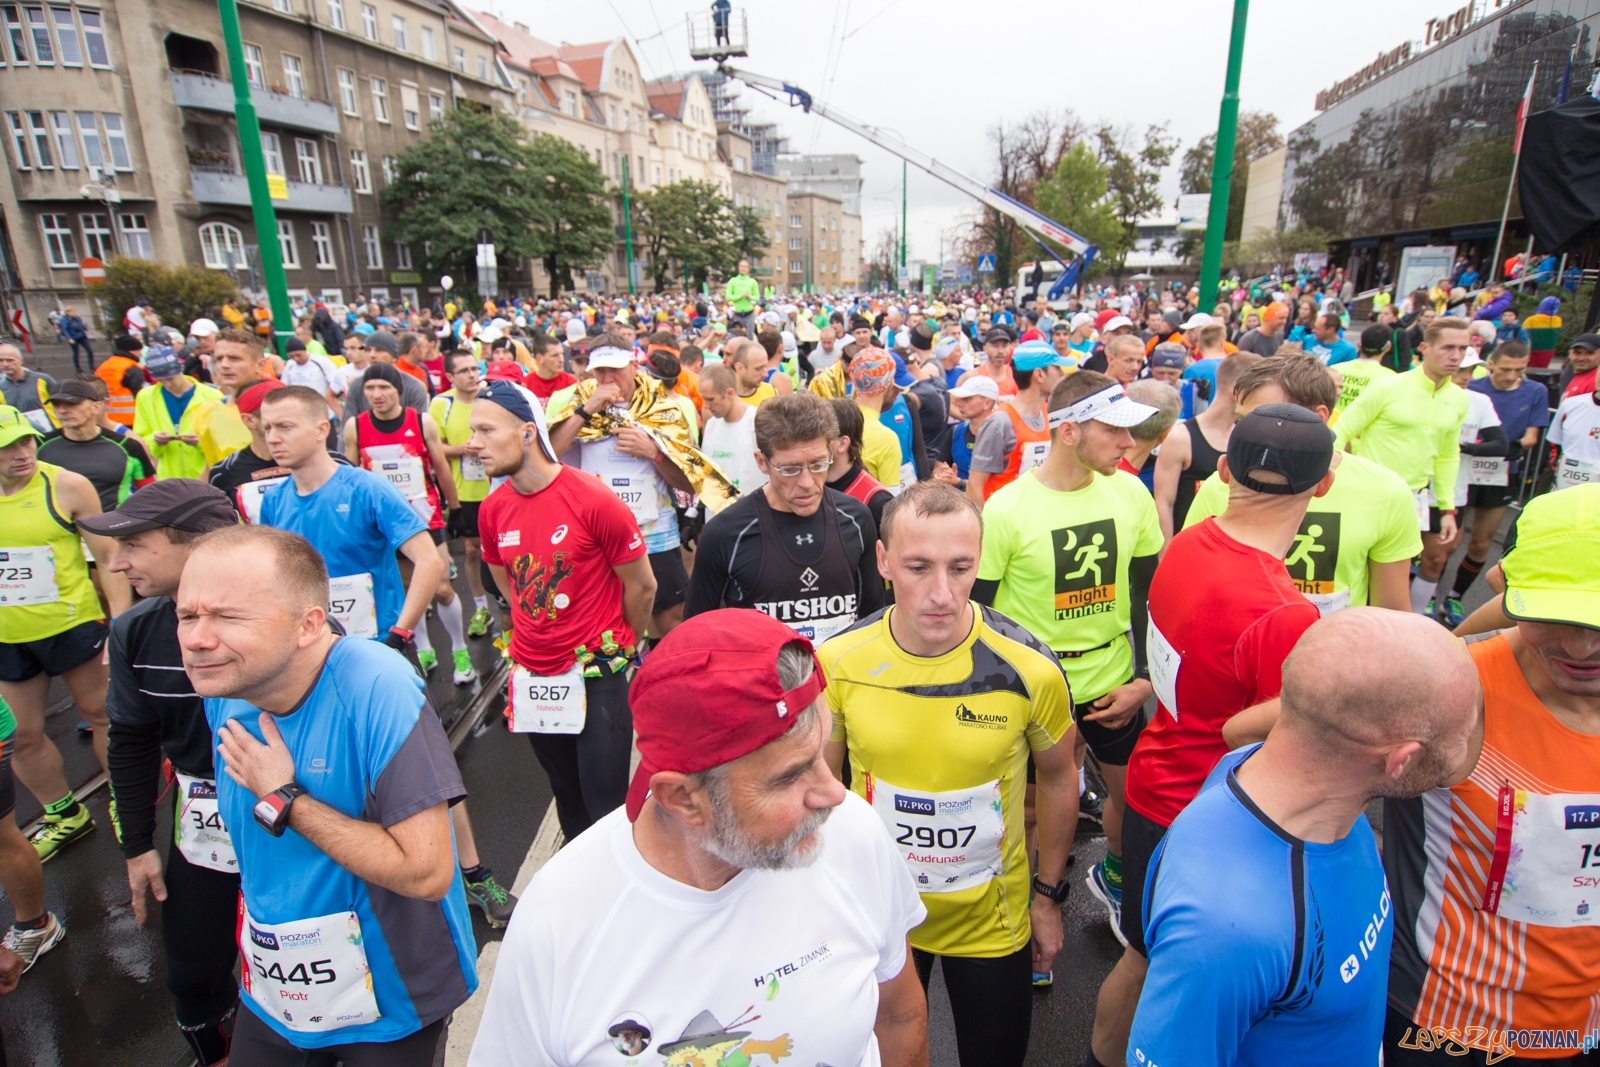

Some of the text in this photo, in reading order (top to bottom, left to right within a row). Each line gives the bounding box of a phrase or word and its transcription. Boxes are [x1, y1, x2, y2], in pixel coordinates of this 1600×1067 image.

[1472, 461, 1499, 470] 3109
[1563, 469, 1591, 483] 2165
[1069, 586, 1108, 606] night
[1055, 601, 1117, 620] runners
[529, 686, 570, 701] 6267
[536, 704, 563, 713] Mateusz
[977, 714, 1008, 723] KAUNO
[959, 721, 1008, 731] MARATONO KLUBAS
[896, 823, 977, 849] 2907
[907, 852, 965, 864] Audrunas
[282, 935, 322, 949] maraton
[799, 944, 831, 967] ZIMNIK
[253, 954, 337, 986] 5445
[280, 990, 309, 1002] Piotr
[309, 1015, 323, 1023] 4F
